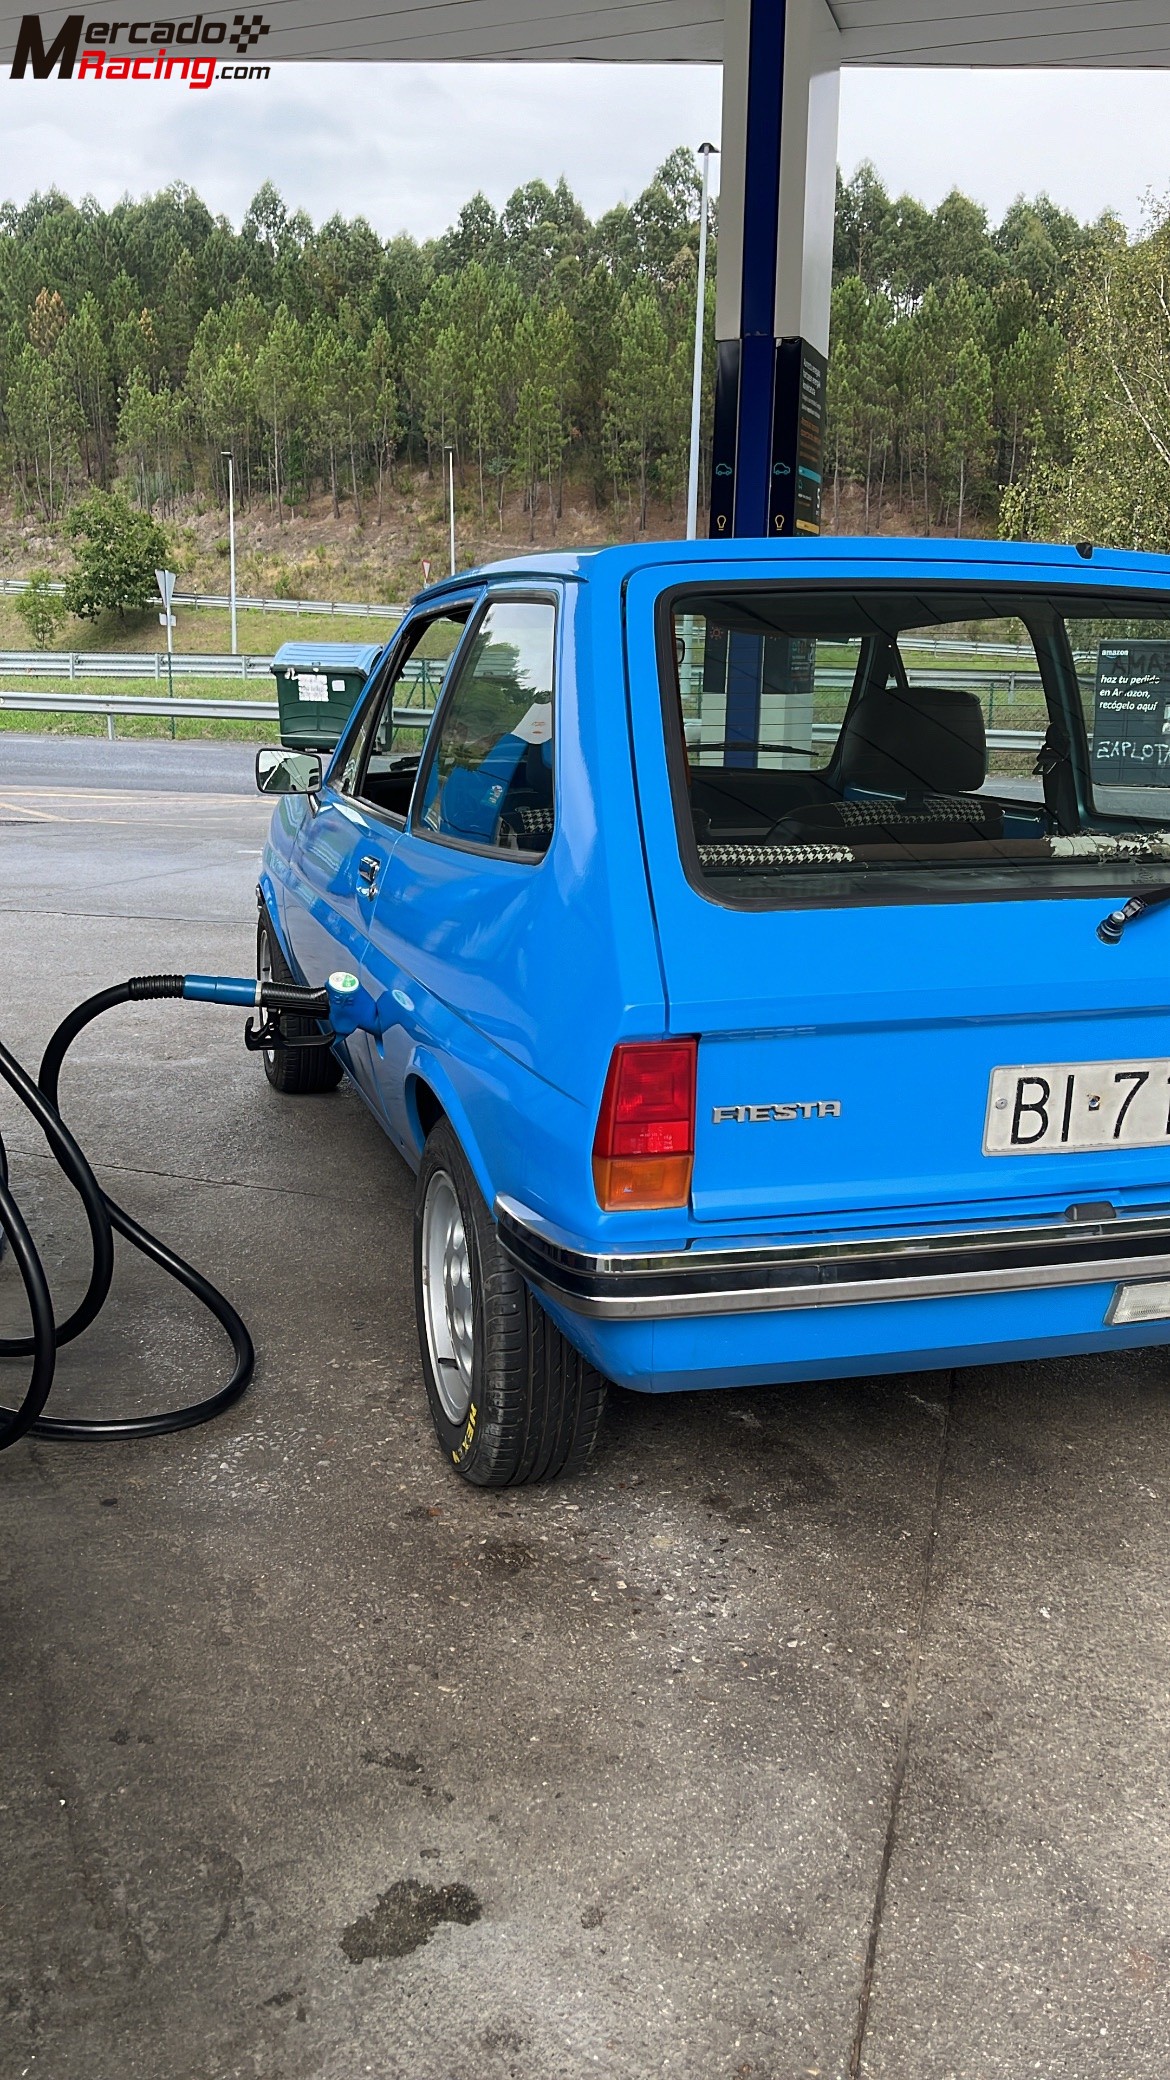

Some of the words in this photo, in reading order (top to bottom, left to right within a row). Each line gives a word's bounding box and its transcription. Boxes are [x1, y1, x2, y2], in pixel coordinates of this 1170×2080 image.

[1100, 675, 1117, 683] haz
[1099, 701, 1135, 711] recógelo
[1137, 702, 1158, 712] aquí
[711, 1101, 842, 1124] FIESTA
[1010, 1075, 1074, 1145] BI
